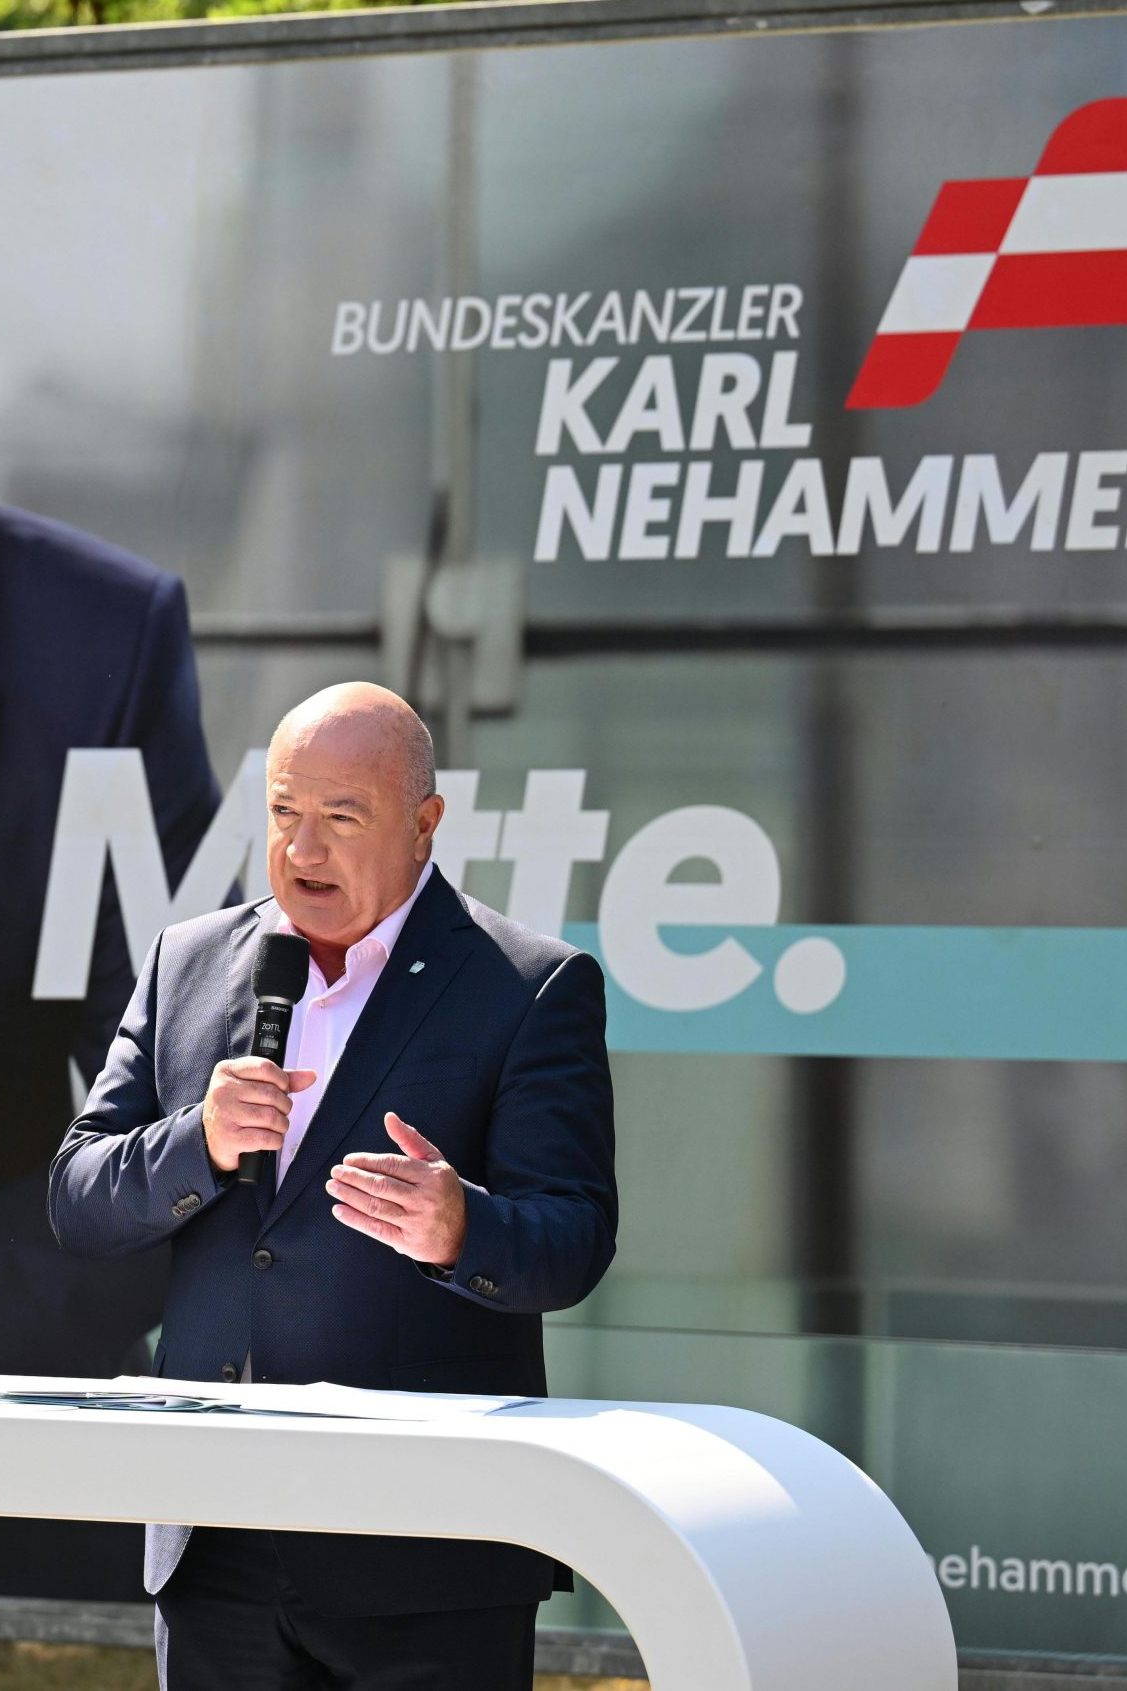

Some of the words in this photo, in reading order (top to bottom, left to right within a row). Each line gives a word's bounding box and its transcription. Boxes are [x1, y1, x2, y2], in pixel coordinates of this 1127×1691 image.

[332, 285, 803, 354] BUNDESKANZLER
[534, 351, 811, 456] KARL
[534, 450, 1127, 561] NEHAMME
[31, 748, 847, 1014] Mte.
[925, 1545, 1127, 1597] ehamm
